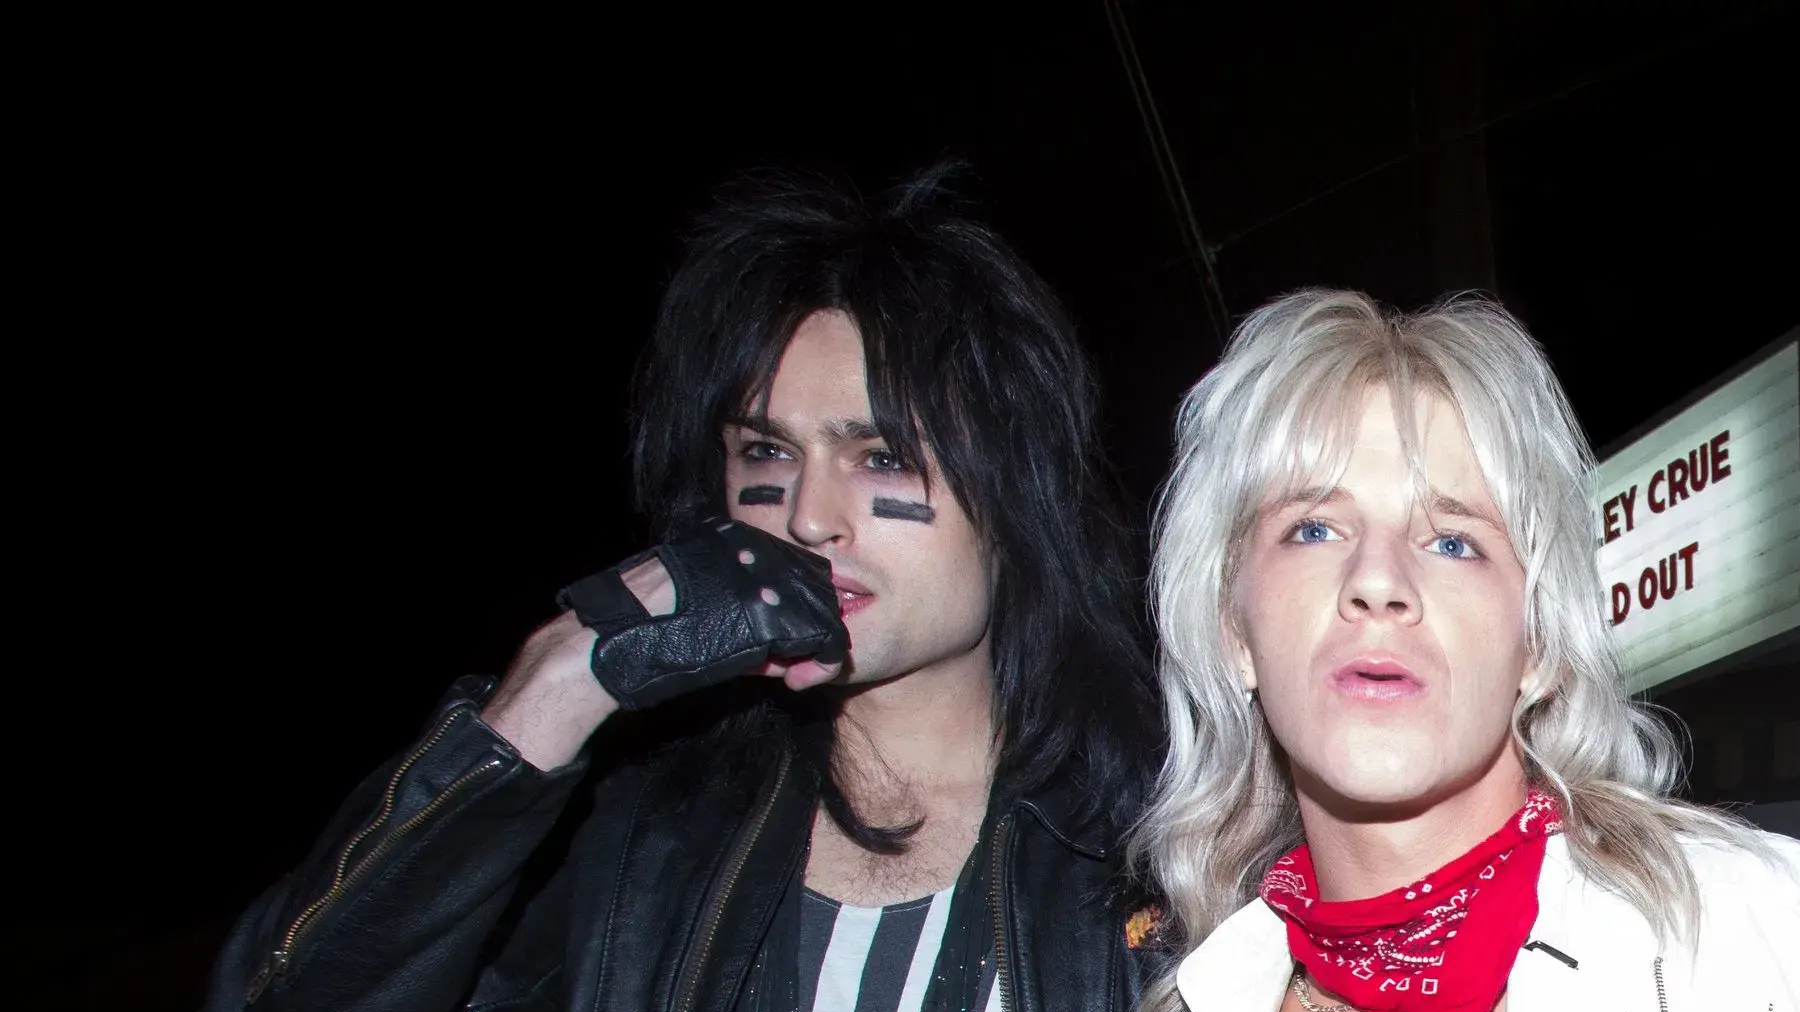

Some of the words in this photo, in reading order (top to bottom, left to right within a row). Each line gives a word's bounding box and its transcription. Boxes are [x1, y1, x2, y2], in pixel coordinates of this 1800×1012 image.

[1598, 485, 1637, 547] EY
[1647, 430, 1732, 514] CRUE
[1638, 541, 1699, 610] OUT
